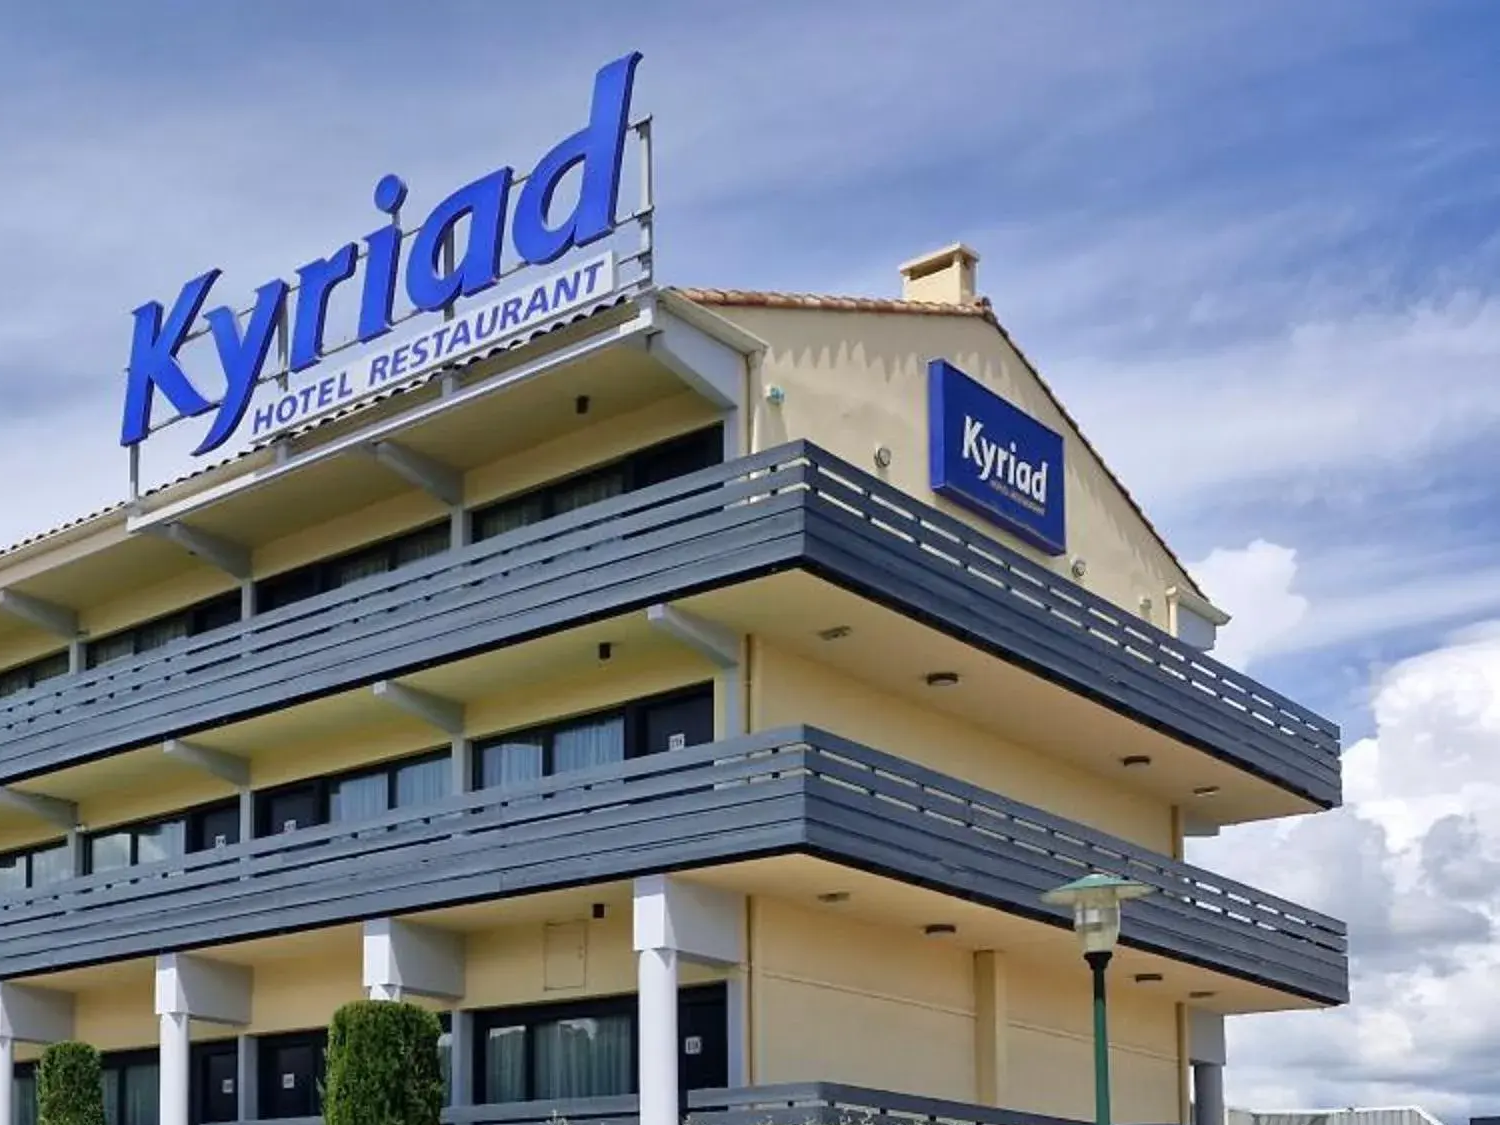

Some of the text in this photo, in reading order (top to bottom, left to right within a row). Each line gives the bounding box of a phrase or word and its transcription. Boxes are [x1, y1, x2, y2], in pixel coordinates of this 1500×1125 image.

[120, 51, 643, 457] Kyriad
[252, 261, 605, 435] HOTEL RESTAURANT
[962, 415, 1049, 503] Kyriad
